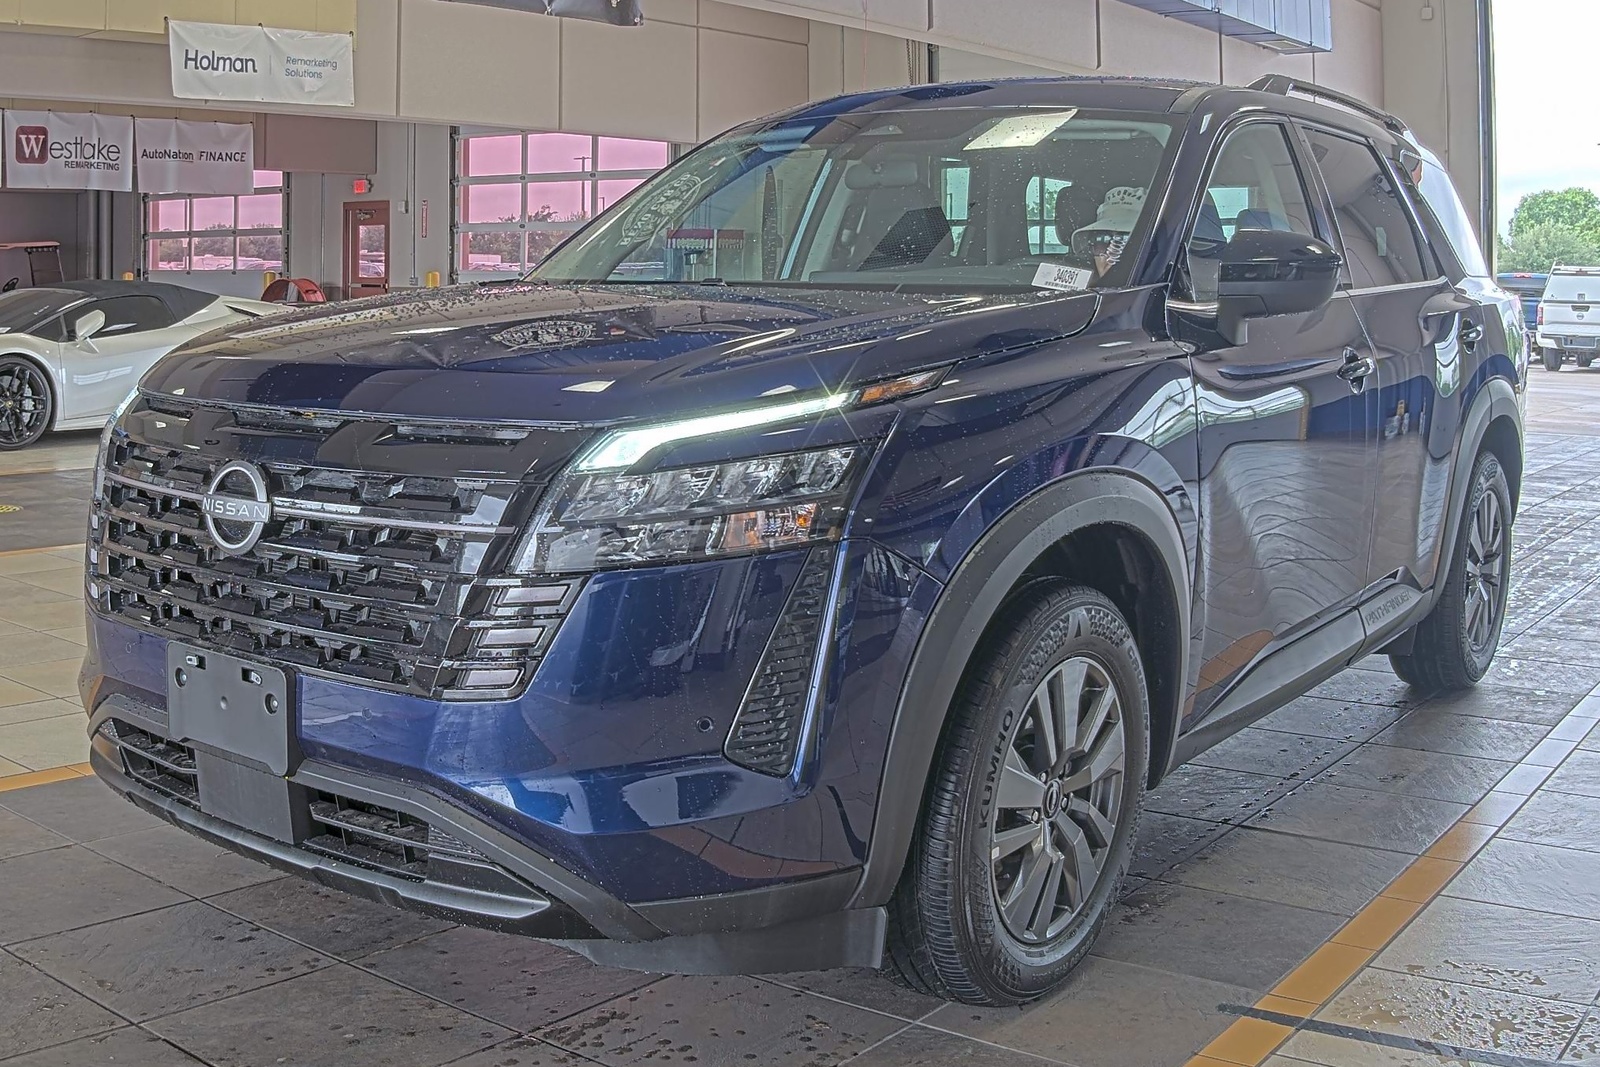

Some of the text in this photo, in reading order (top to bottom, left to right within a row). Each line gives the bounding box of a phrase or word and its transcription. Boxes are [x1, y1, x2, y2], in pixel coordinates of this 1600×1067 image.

[184, 49, 258, 74] Holman
[285, 55, 338, 71] Remarketing
[284, 67, 323, 80] Solutions
[19, 133, 121, 162] Westlake
[141, 148, 247, 163] AutoNation FINANCE
[64, 160, 120, 171] REMARKETING
[1054, 268, 1079, 285] 340391
[202, 496, 267, 519] NISSAN
[1364, 589, 1412, 626] PATHFINDER
[978, 708, 1014, 830] KUMHO
